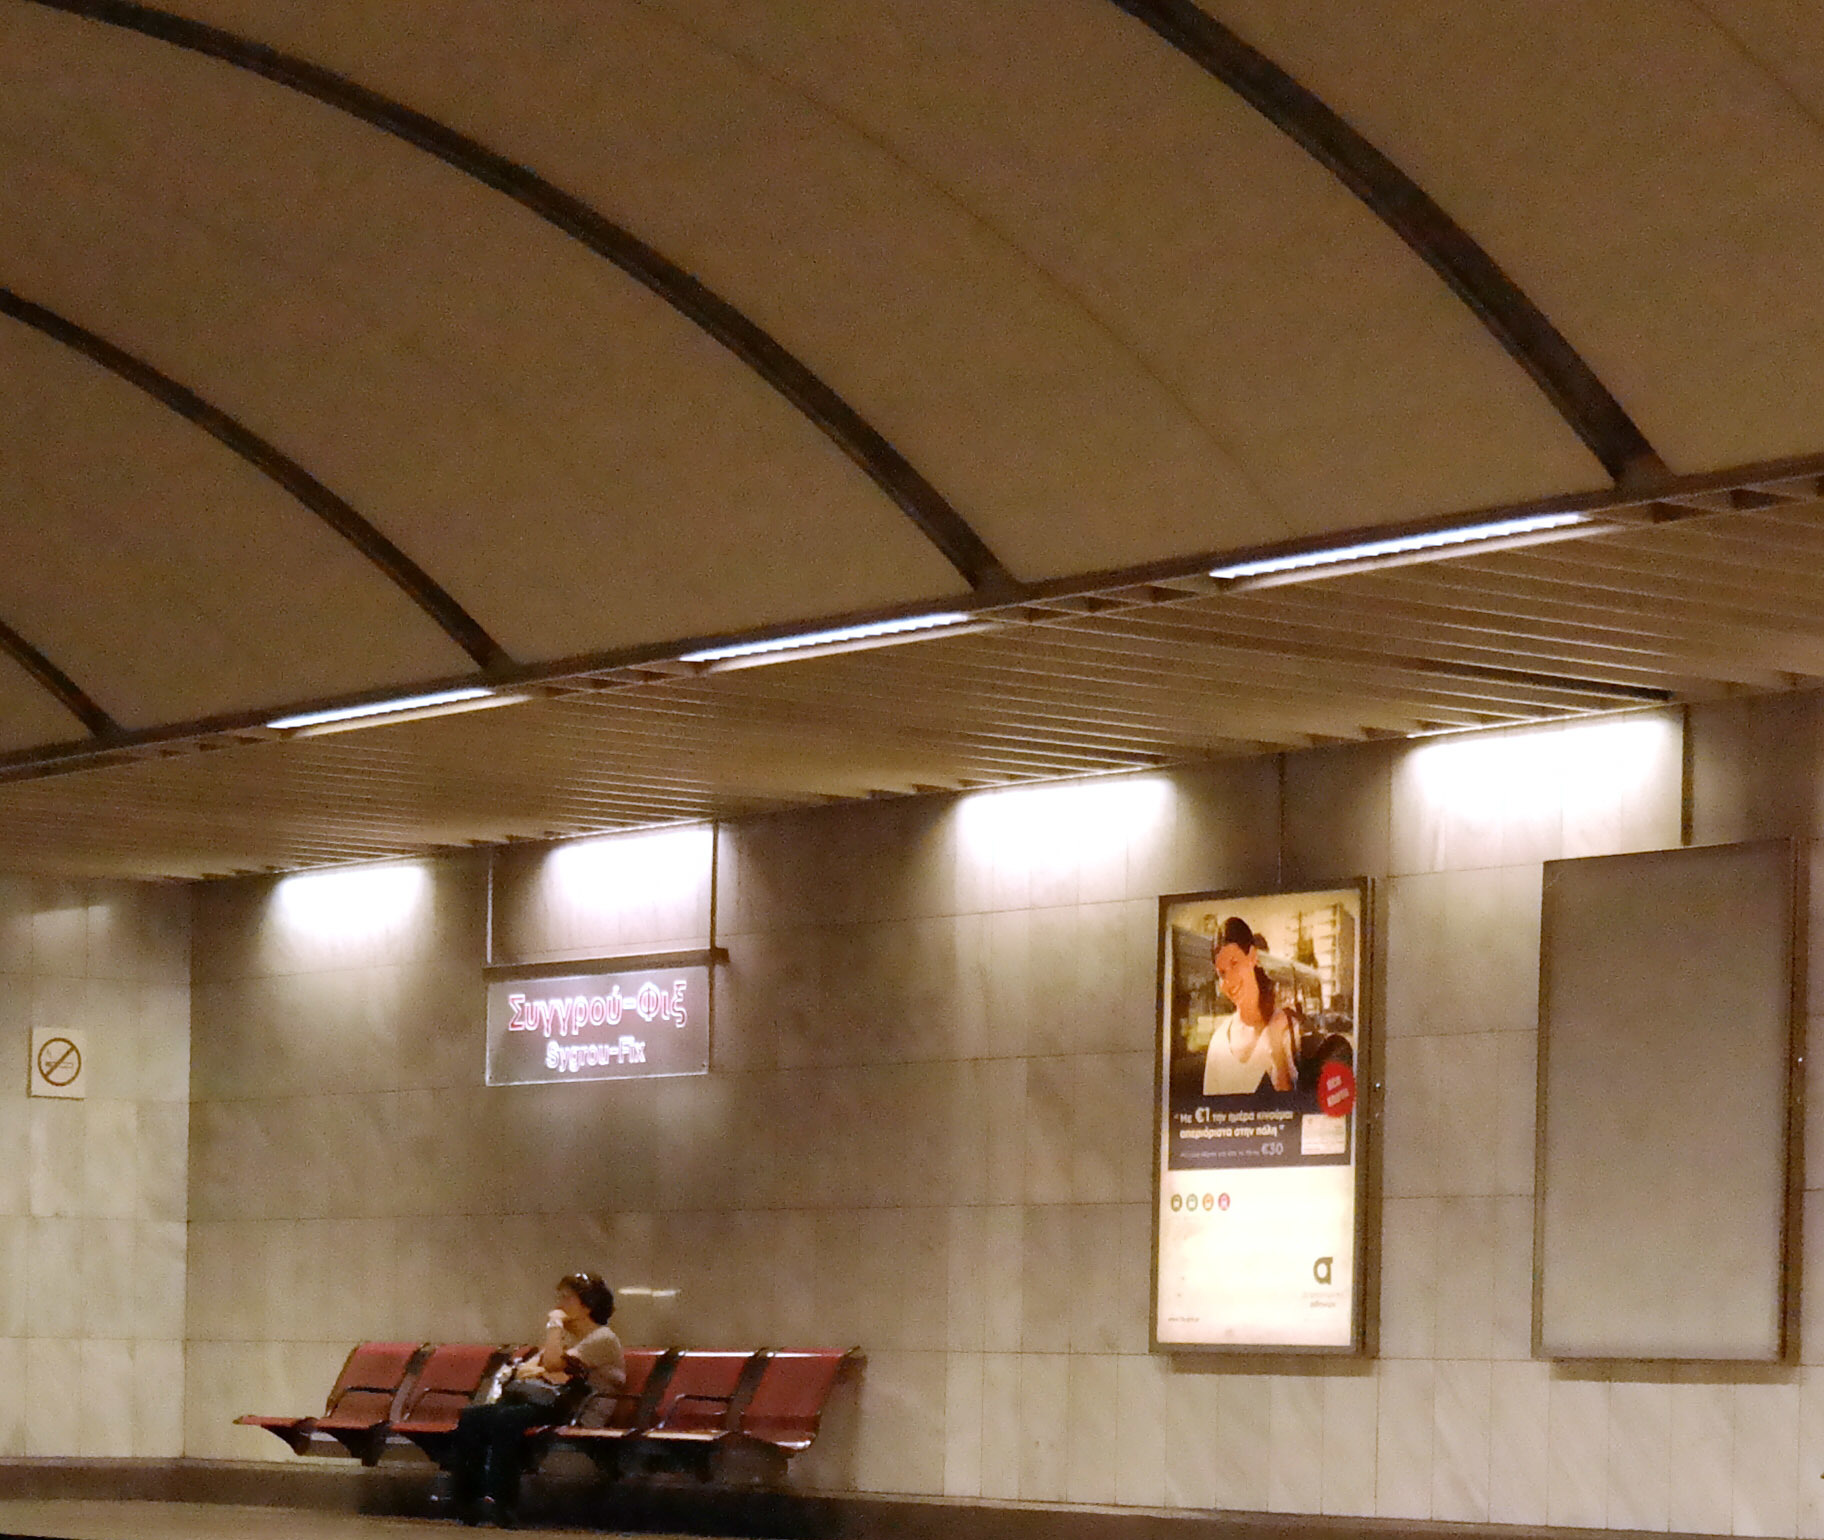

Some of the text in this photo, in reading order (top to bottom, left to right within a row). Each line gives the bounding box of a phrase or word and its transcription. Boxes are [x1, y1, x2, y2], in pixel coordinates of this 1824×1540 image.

[508, 980, 688, 1038] Συγγρού-Φιξ
[545, 1035, 647, 1073] Sygrou-Fix
[1195, 1106, 1211, 1124] €1
[1261, 1142, 1284, 1156] €30
